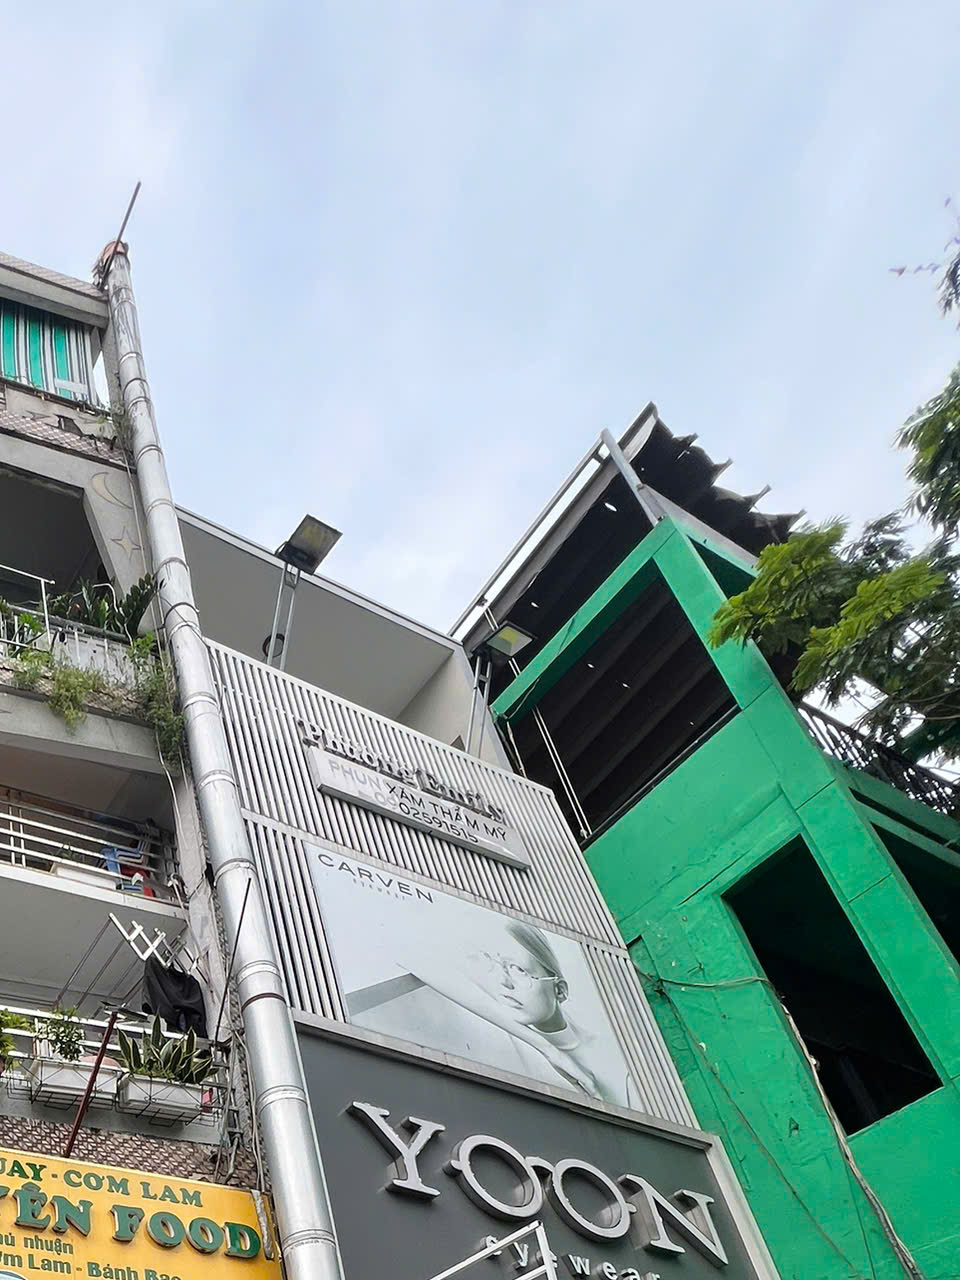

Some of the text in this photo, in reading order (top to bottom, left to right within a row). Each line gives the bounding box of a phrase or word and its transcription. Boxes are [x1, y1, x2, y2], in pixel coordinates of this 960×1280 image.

[317, 853, 434, 904] CARVEN
[63, 1168, 130, 1196] CƠM
[139, 1181, 203, 1208] LAM
[347, 1100, 730, 1270] YOON
[110, 1204, 262, 1260] FOOD
[28, 1253, 72, 1275] Lam
